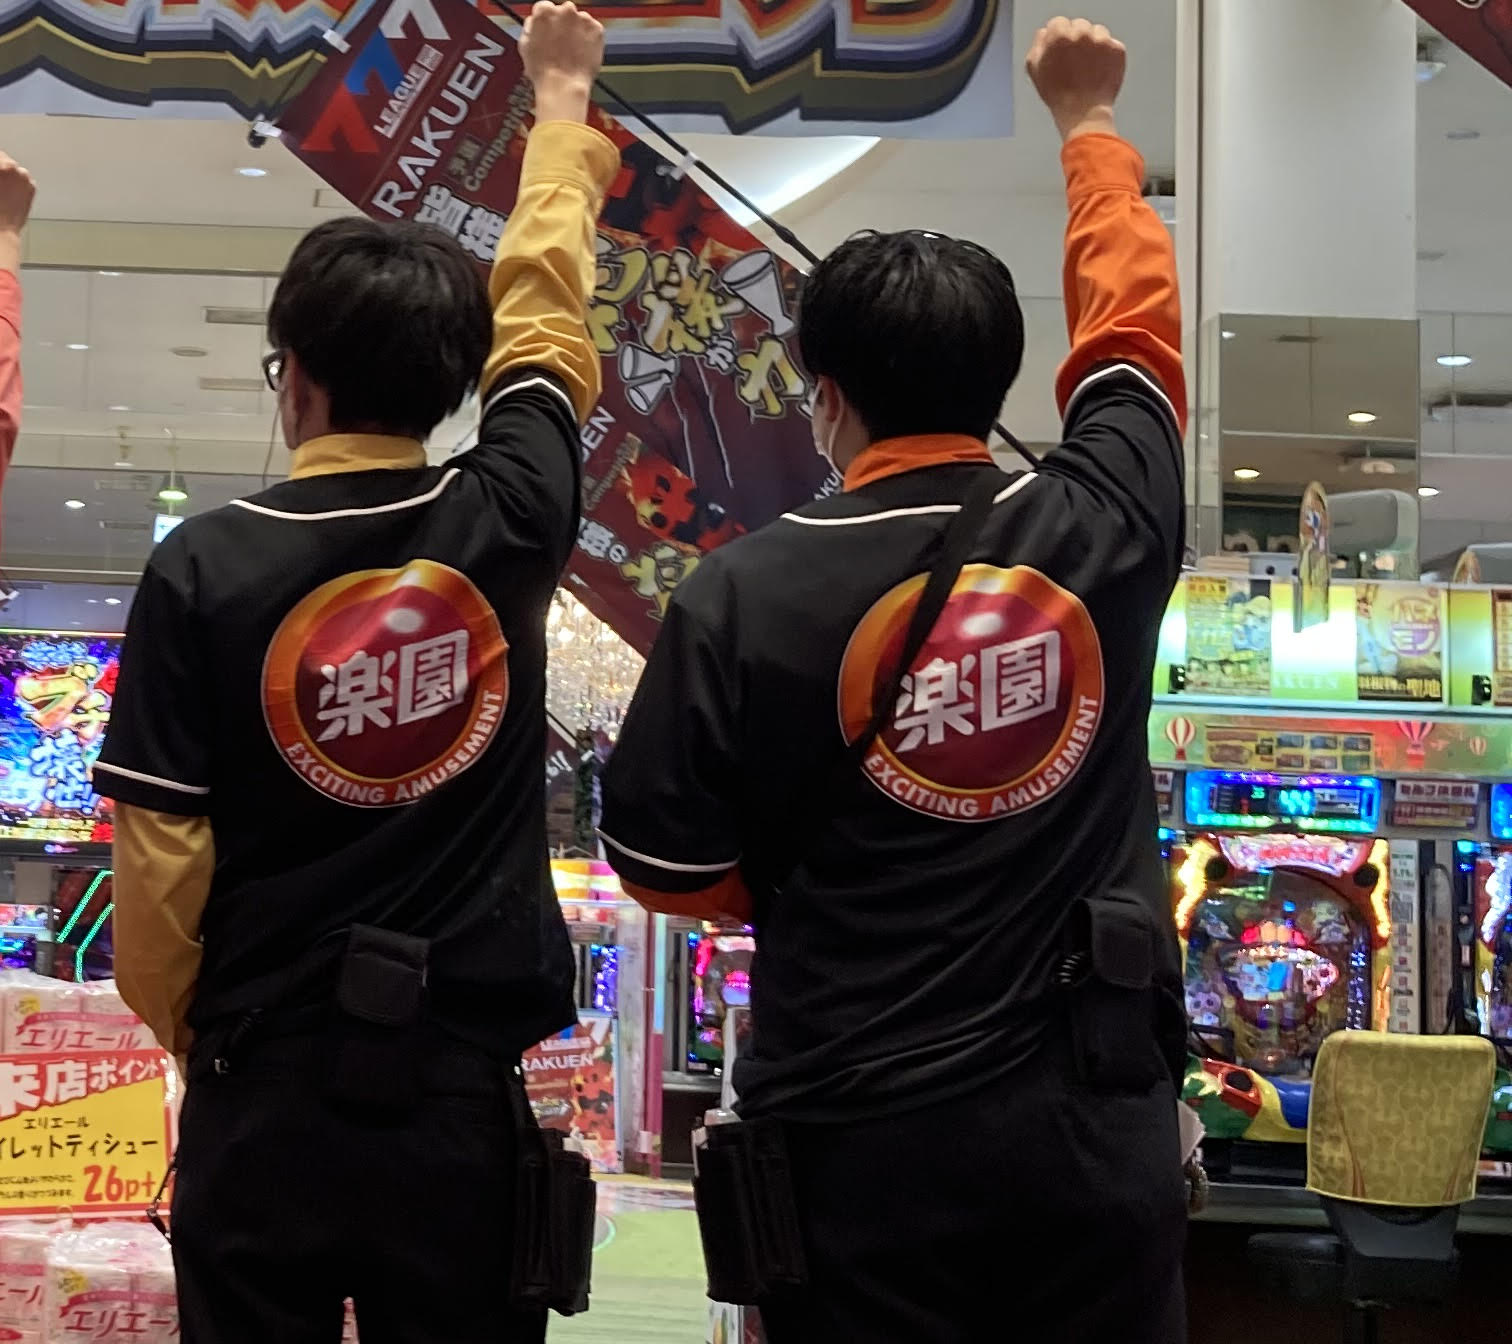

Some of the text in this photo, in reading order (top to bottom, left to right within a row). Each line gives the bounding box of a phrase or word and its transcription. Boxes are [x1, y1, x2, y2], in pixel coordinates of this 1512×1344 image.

[371, 32, 505, 219] RAKUEN
[316, 629, 470, 742] 楽園
[893, 630, 1061, 753] 楽園
[286, 741, 387, 804] EXCITING
[393, 689, 503, 803] AMUSEMENT
[864, 695, 1100, 818] EXCITING AMUSEMENT
[21, 1028, 142, 1051] エリエール
[23, 1115, 91, 1131] エリエール
[82, 1164, 156, 1203] 26pt
